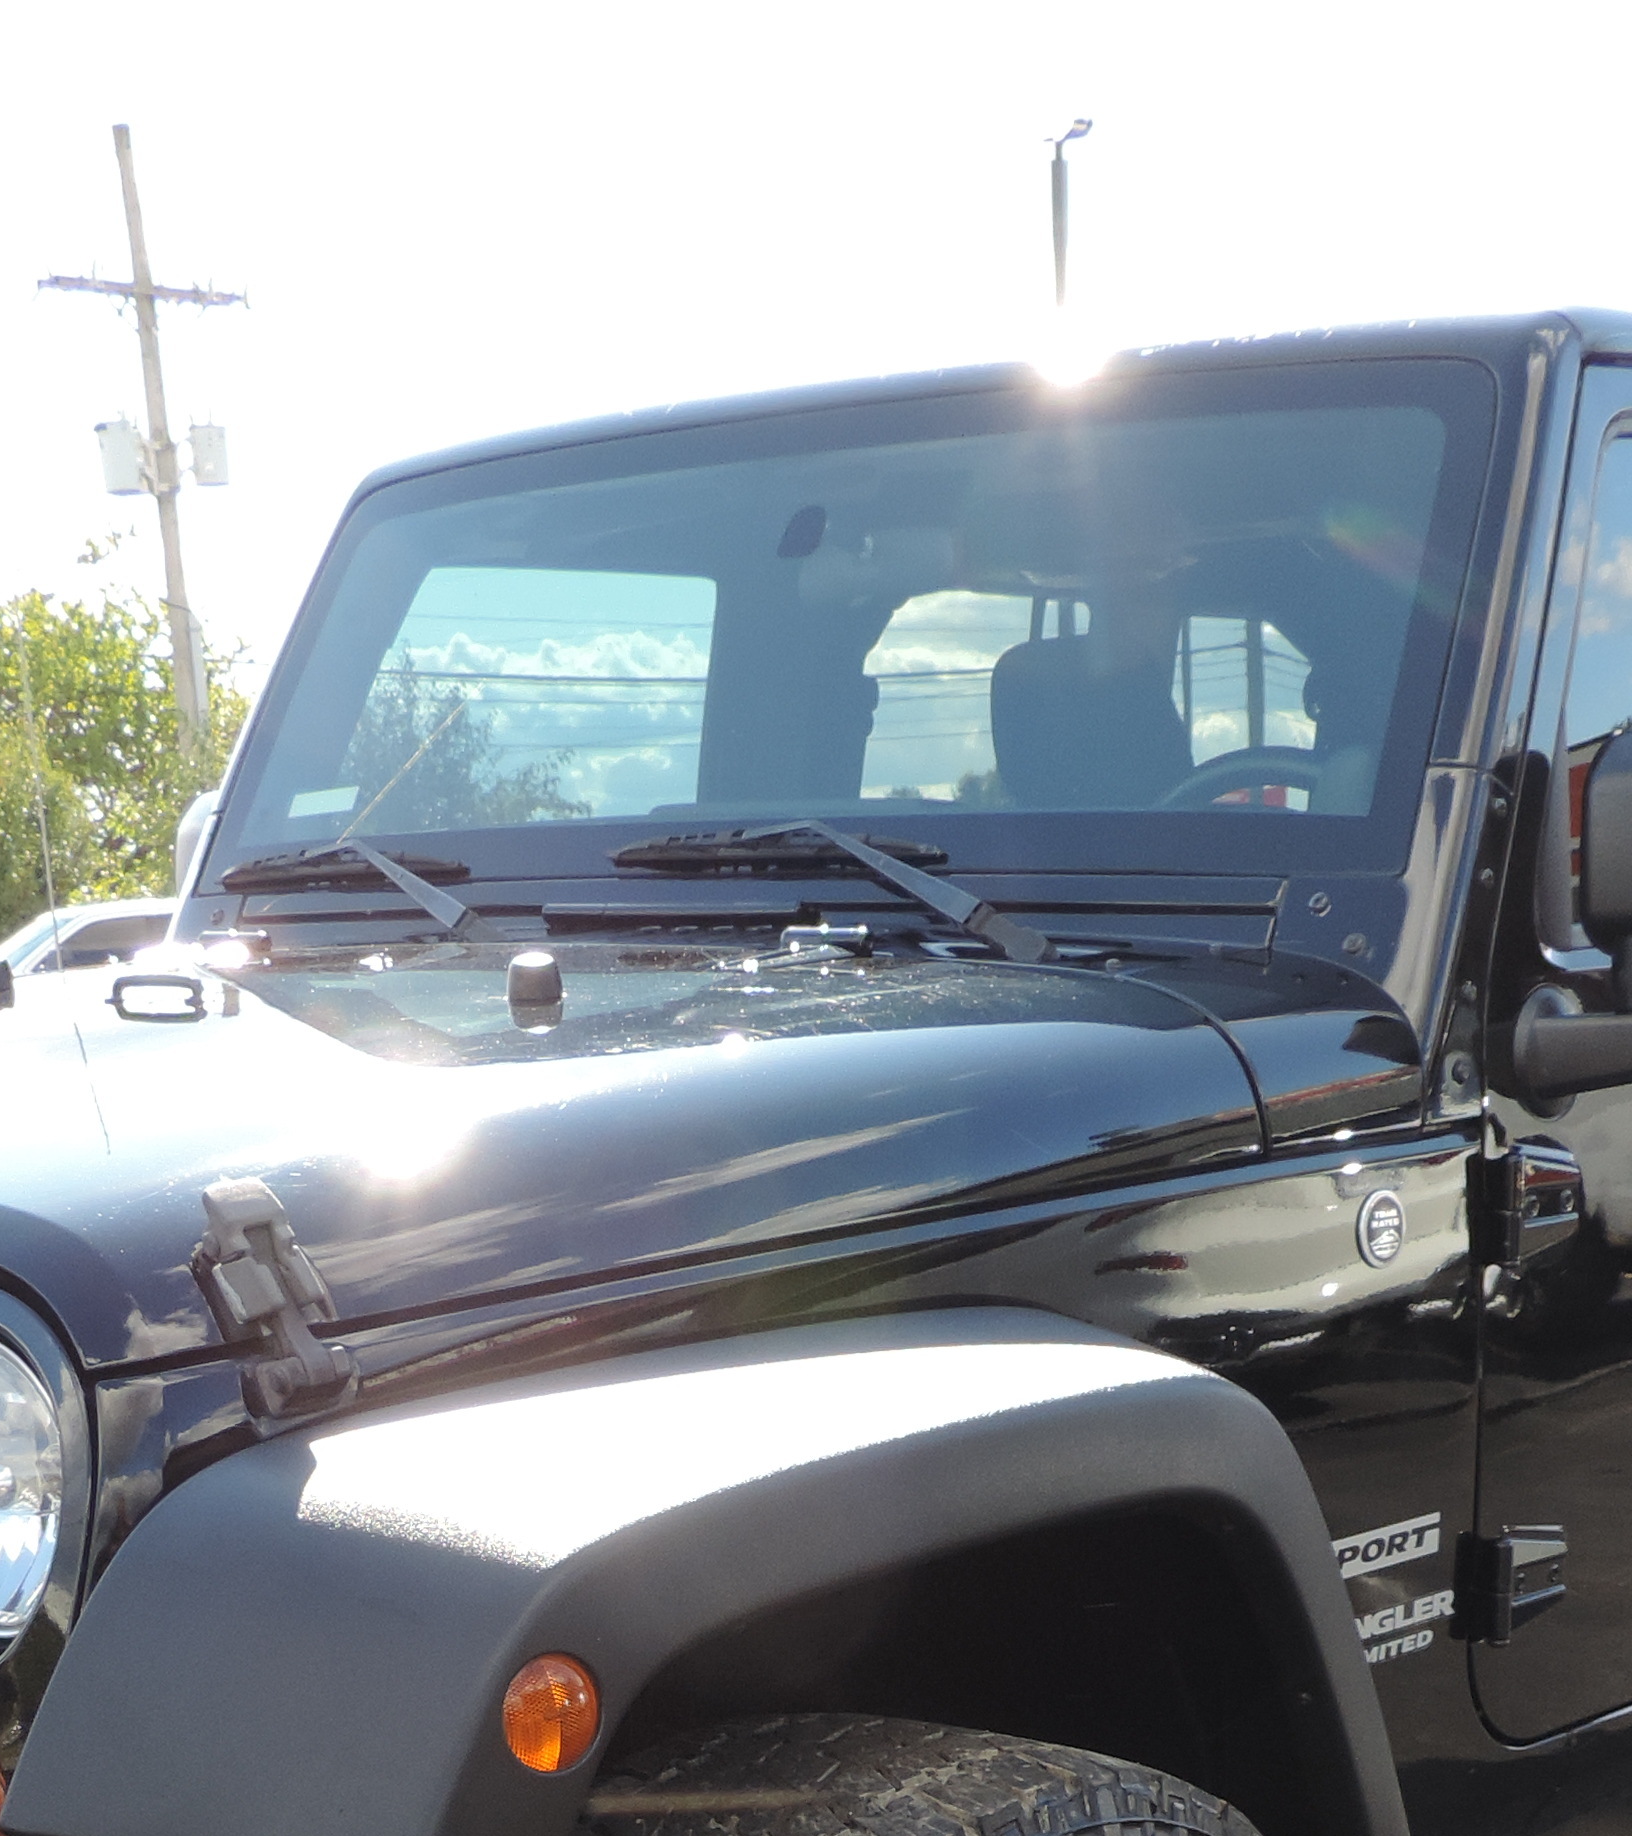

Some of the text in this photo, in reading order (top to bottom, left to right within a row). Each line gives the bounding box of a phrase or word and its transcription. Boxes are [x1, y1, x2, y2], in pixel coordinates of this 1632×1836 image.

[1337, 1522, 1441, 1565] PORT
[1355, 1589, 1455, 1640] NGLER
[1364, 1629, 1435, 1664] MITED
